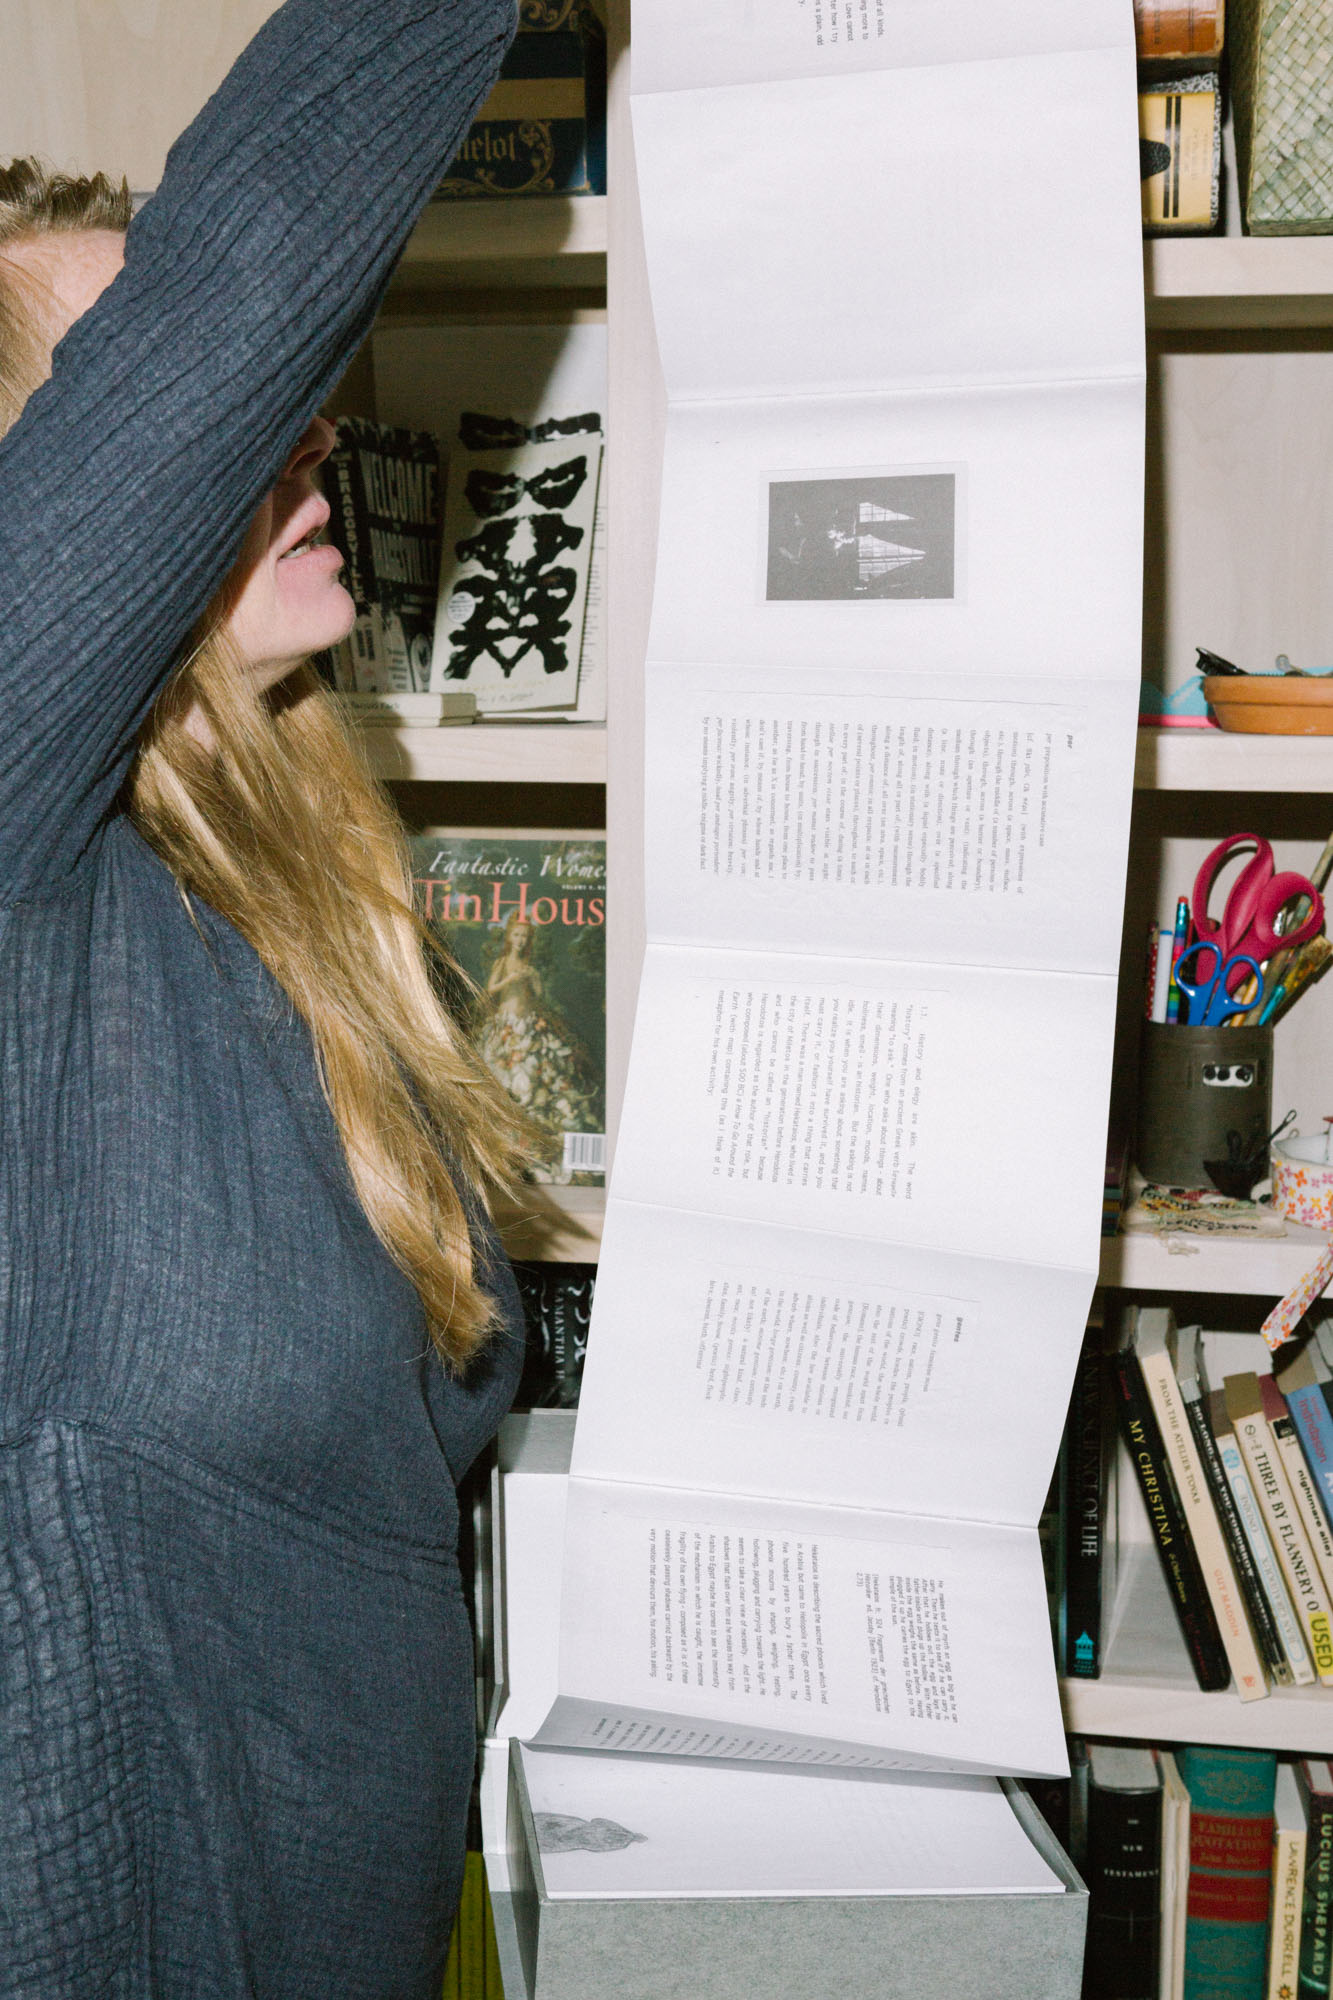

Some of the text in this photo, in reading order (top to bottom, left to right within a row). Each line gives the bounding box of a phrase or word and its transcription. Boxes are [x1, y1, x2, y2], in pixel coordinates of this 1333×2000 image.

[428, 849, 530, 876] Fantastic
[1158, 1378, 1202, 1505] FROM THE ATELIER TOVAR
[1254, 1451, 1281, 1500] THREE
[1081, 1498, 1098, 1522] OF
[1127, 1419, 1173, 1546] MY CHRISTINA
[1271, 1501, 1288, 1522] BY
[1296, 1469, 1333, 1558] nightmare alley
[1081, 1526, 1098, 1556] LIFE
[1210, 1461, 1224, 1482] SEE
[1218, 1484, 1232, 1507] YOU
[1227, 1511, 1255, 1578] TOMORROW
[1278, 1523, 1314, 1596] FLANNERY
[1212, 1568, 1241, 1638] GUY MADDIN
[1309, 1616, 1333, 1670] USED
[1104, 1868, 1159, 1878] TESTAMENT
[1313, 1814, 1333, 1976] LUCIUS SHEPARD
[1281, 1842, 1299, 1977] LAWRENCE DURRELL
